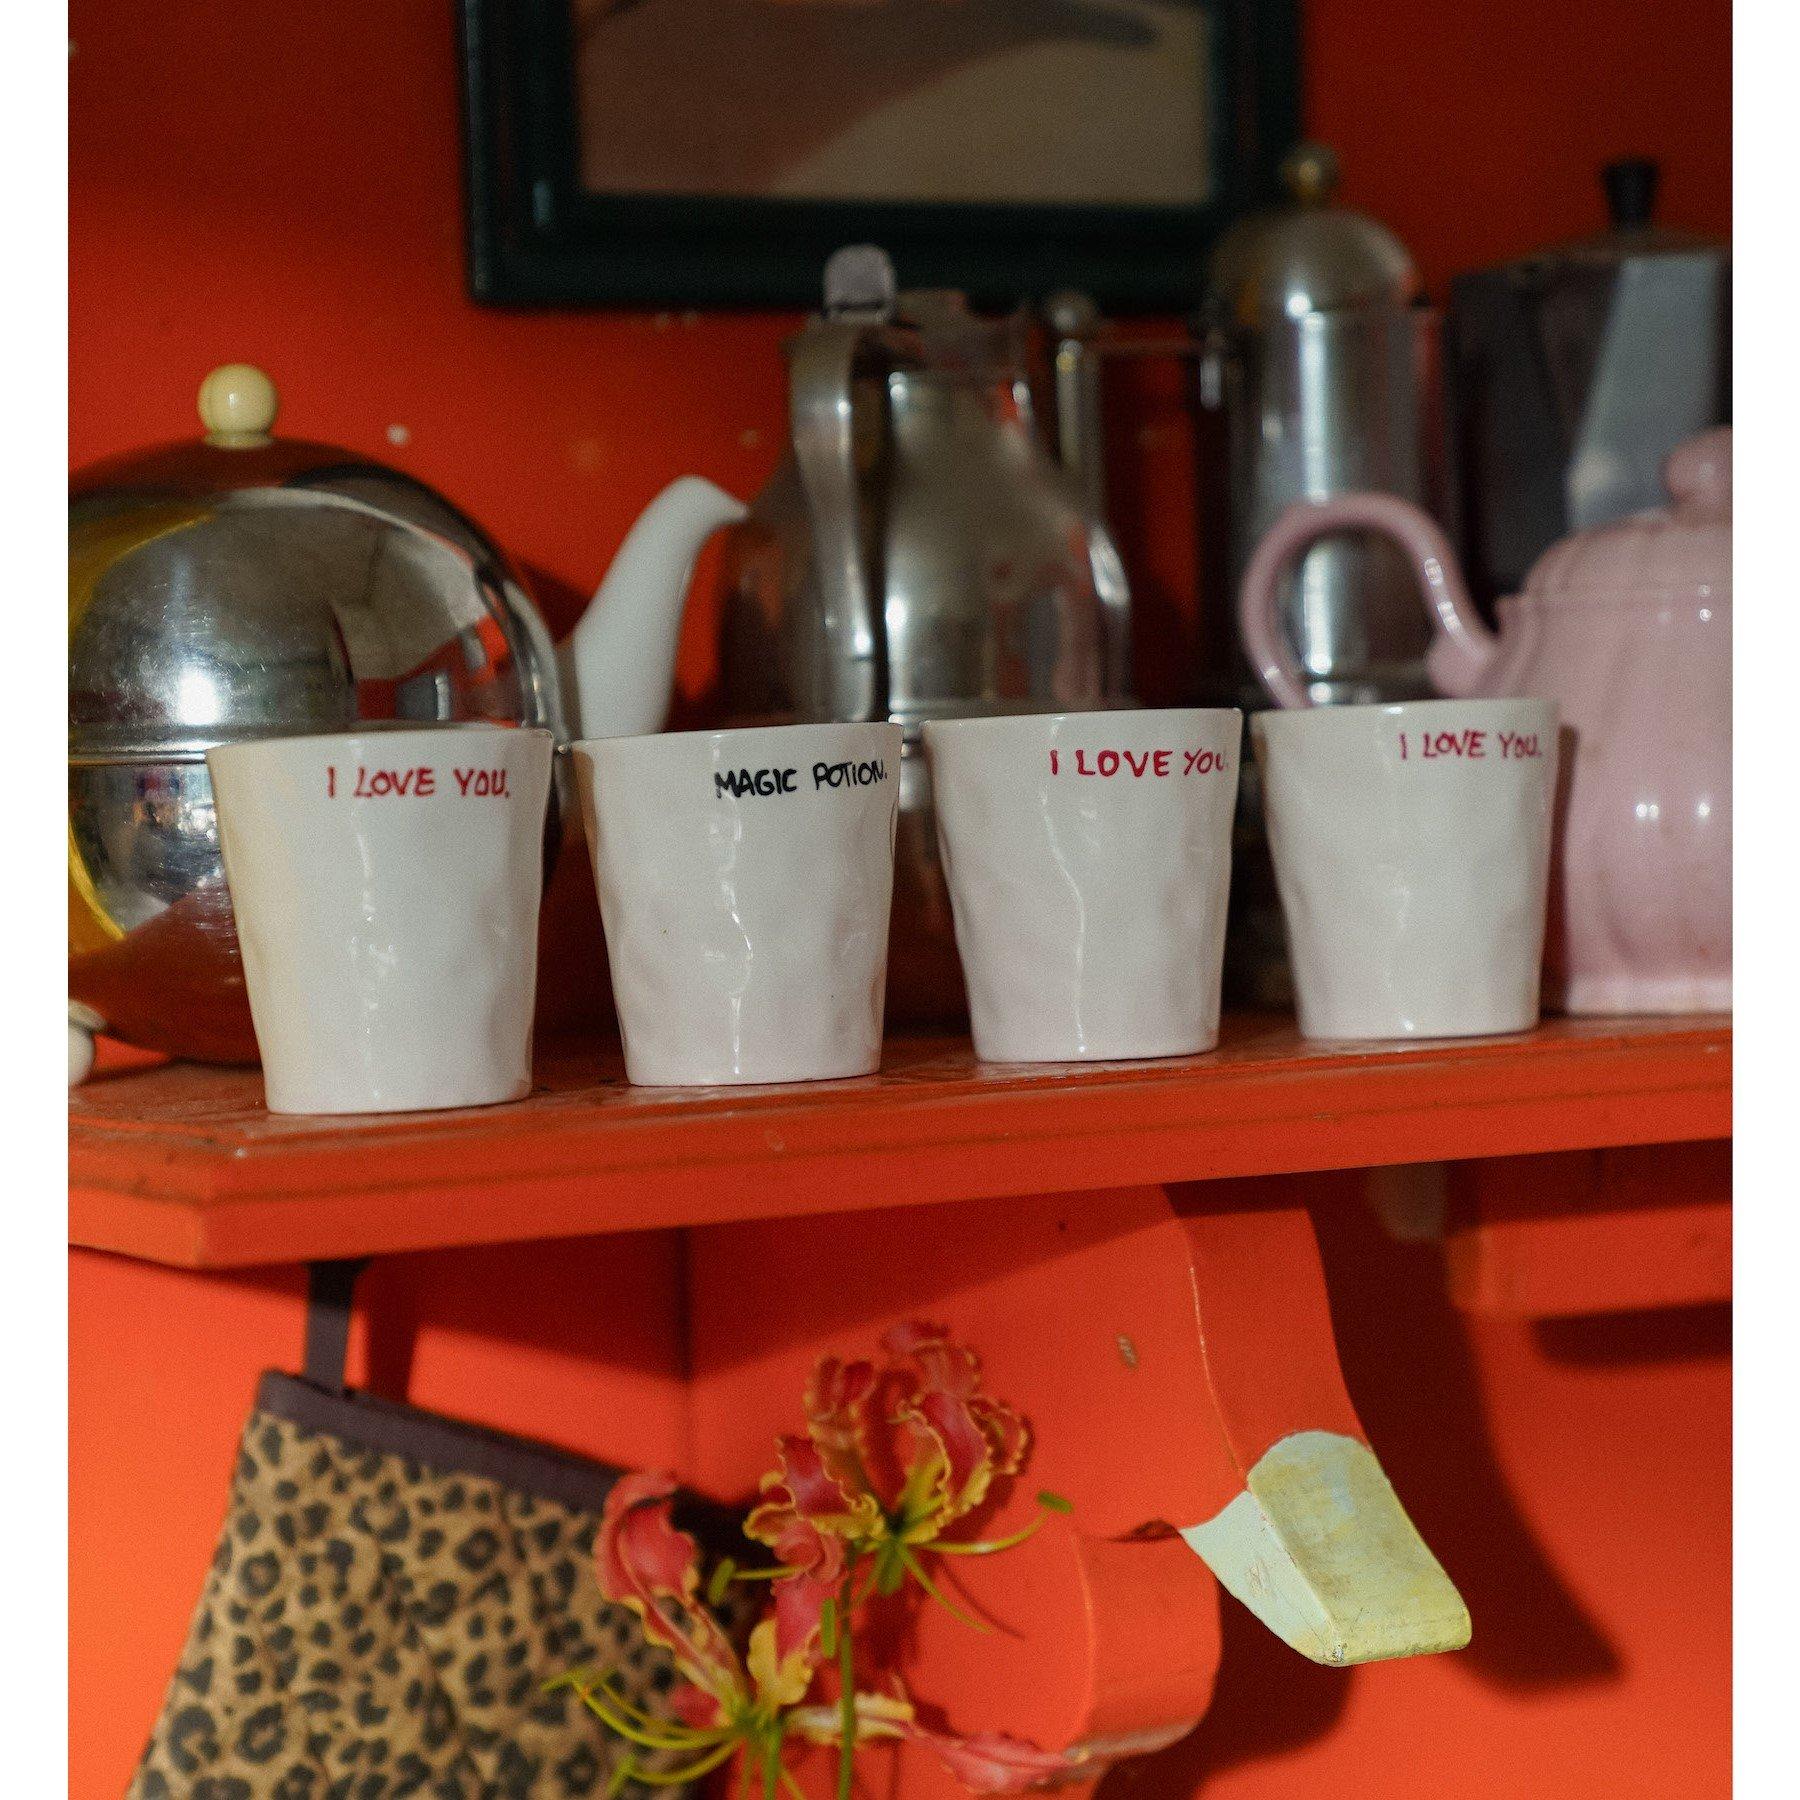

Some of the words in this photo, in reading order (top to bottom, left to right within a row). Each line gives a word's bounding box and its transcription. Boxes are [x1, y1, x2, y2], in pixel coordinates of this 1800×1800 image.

[1399, 732, 1407, 759] I
[1423, 729, 1486, 759] LOVE
[714, 768, 797, 799] MAGIC
[812, 758, 888, 790] POTION.
[1050, 749, 1058, 775] I
[1075, 749, 1173, 777] LOVE
[327, 766, 336, 798] I
[354, 766, 435, 798] LOVE
[453, 768, 511, 799] YOU.
